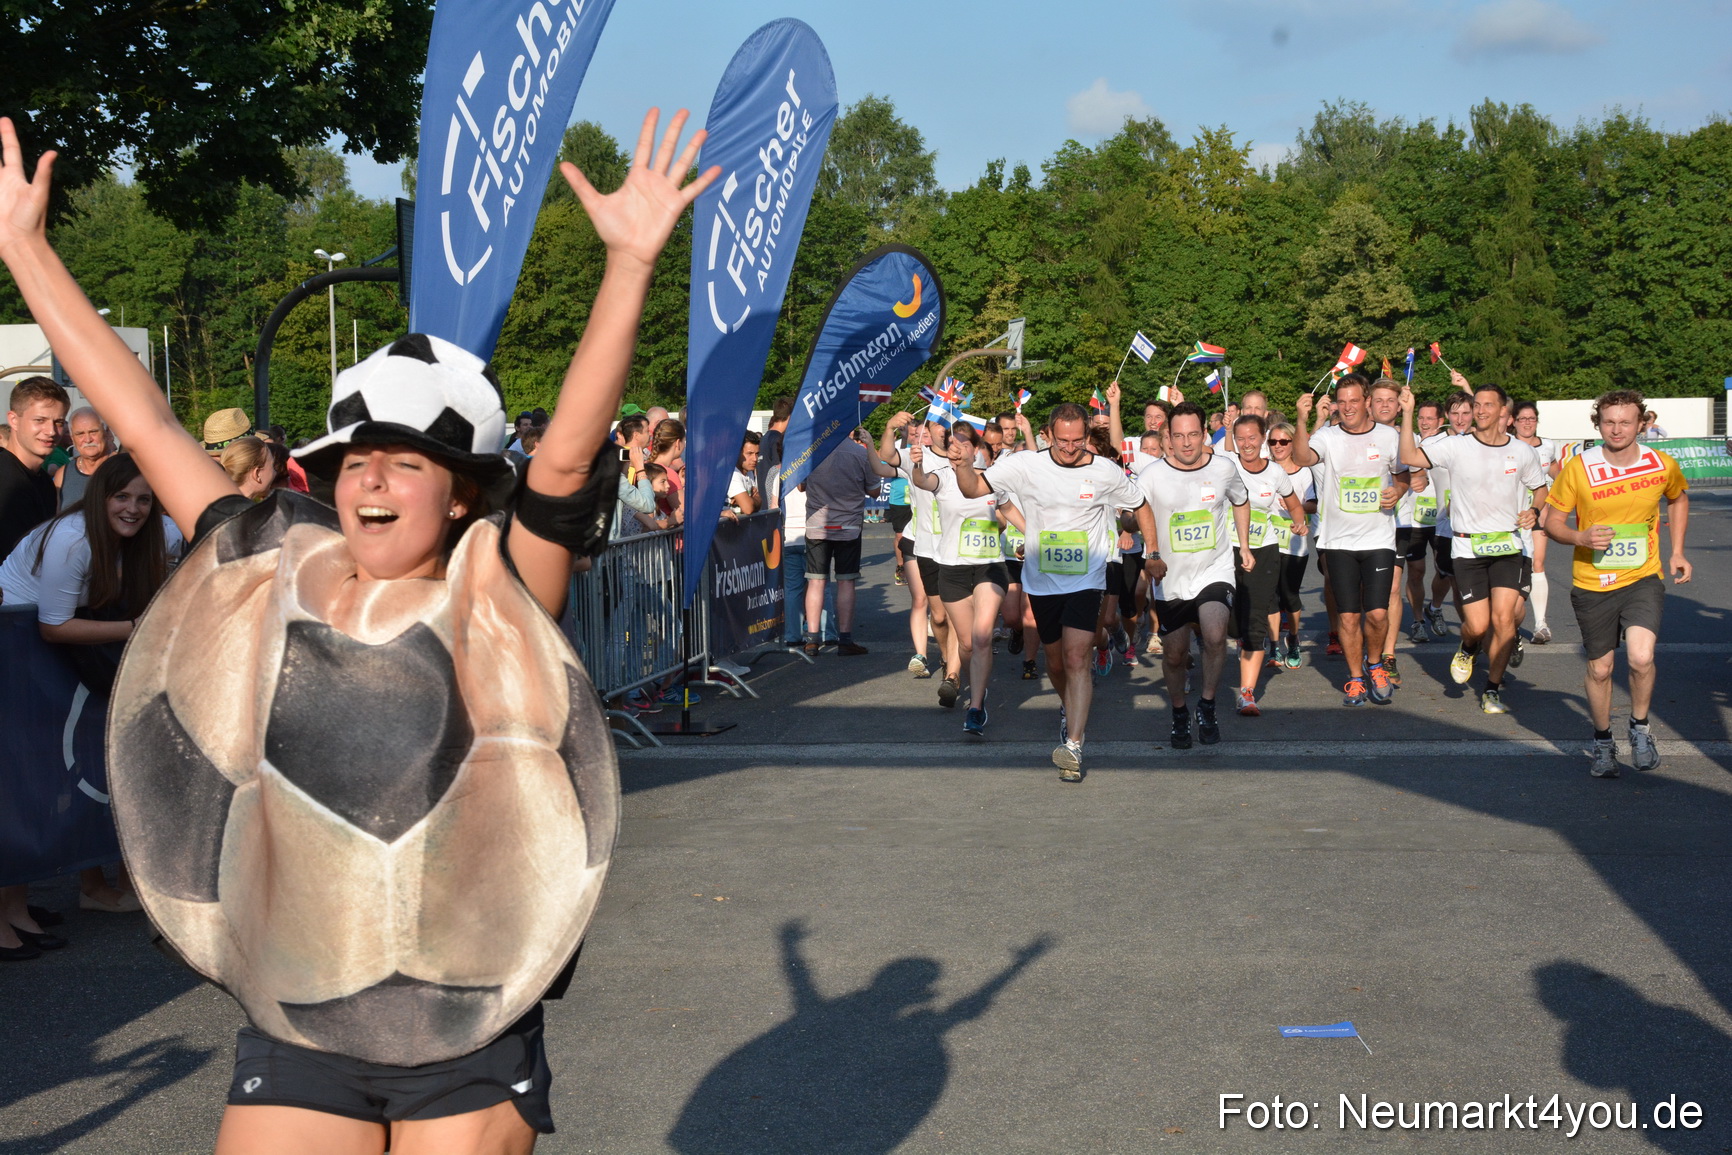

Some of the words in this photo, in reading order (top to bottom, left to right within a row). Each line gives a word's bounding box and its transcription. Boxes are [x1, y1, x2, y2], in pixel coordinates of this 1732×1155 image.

[502, 0, 586, 228] AUTOMOBIL
[726, 68, 801, 297] Fischer
[866, 353, 891, 379] Druck
[907, 312, 937, 345] Medien
[802, 322, 902, 419] Frischmann
[1712, 457, 1732, 468] HÄN
[1592, 485, 1627, 501] MAX
[1630, 476, 1667, 491] BÖGL
[1344, 491, 1377, 504] 1529
[1418, 507, 1437, 517] 150
[964, 534, 997, 548] 1518
[1174, 525, 1211, 542] 1527
[1044, 548, 1083, 562] 1538
[1477, 543, 1512, 555] 1528
